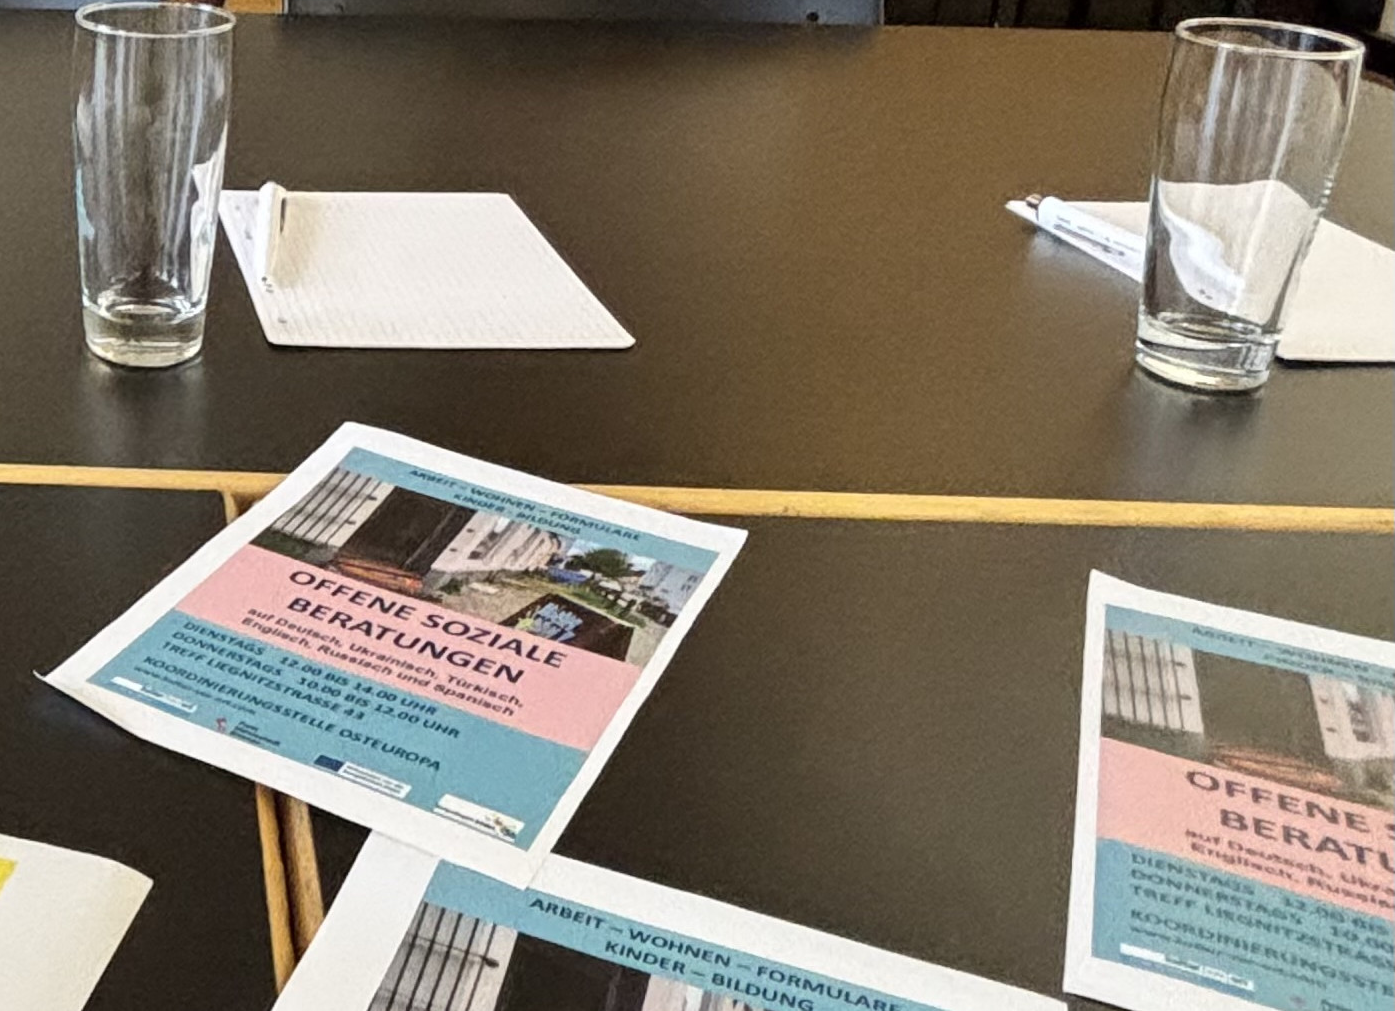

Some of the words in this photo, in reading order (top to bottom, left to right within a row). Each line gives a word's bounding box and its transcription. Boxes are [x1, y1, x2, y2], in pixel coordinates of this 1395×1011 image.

[470, 487, 536, 511] WOHNEN
[550, 511, 640, 541] FORMULARE
[287, 597, 524, 684] BERATUNGEN
[289, 571, 416, 621] OFFENE
[420, 614, 567, 669] SOZIALE
[162, 641, 206, 661] TREFF
[206, 658, 341, 712] LIEGNITZSTRASSE
[172, 631, 282, 676] DONNERSTAGS
[299, 677, 341, 697] 10.00
[344, 694, 369, 707] BIS
[374, 704, 420, 723] 12.00
[423, 719, 460, 738] UHR
[183, 621, 265, 655] DIENSTAGS
[280, 657, 322, 676] 12.00
[324, 673, 348, 686] BIS
[353, 682, 398, 701] 14.00
[400, 698, 437, 715] UHR
[241, 617, 311, 649] Englisch,
[316, 644, 392, 675] Russisch
[396, 672, 431, 687] und
[433, 684, 514, 716] Spanisch
[248, 609, 275, 621] auf
[274, 617, 342, 647] Deutsch,
[349, 643, 437, 680] Ukrainisch,
[448, 674, 523, 708] Türkisch,
[143, 656, 336, 732] KOORDINIERUNGSSTELLE
[339, 729, 440, 772] OSTEUROPA
[1186, 771, 1369, 833] OFFENE
[1130, 868, 1301, 925] DONNERSTAGS
[1131, 853, 1254, 895] DIENSTAGS
[1133, 885, 1196, 909] TREFF
[529, 897, 605, 930] ARBEIT
[628, 927, 732, 968] WOHNEN
[605, 940, 687, 976] KINDER
[711, 972, 815, 1011] BILDUNG
